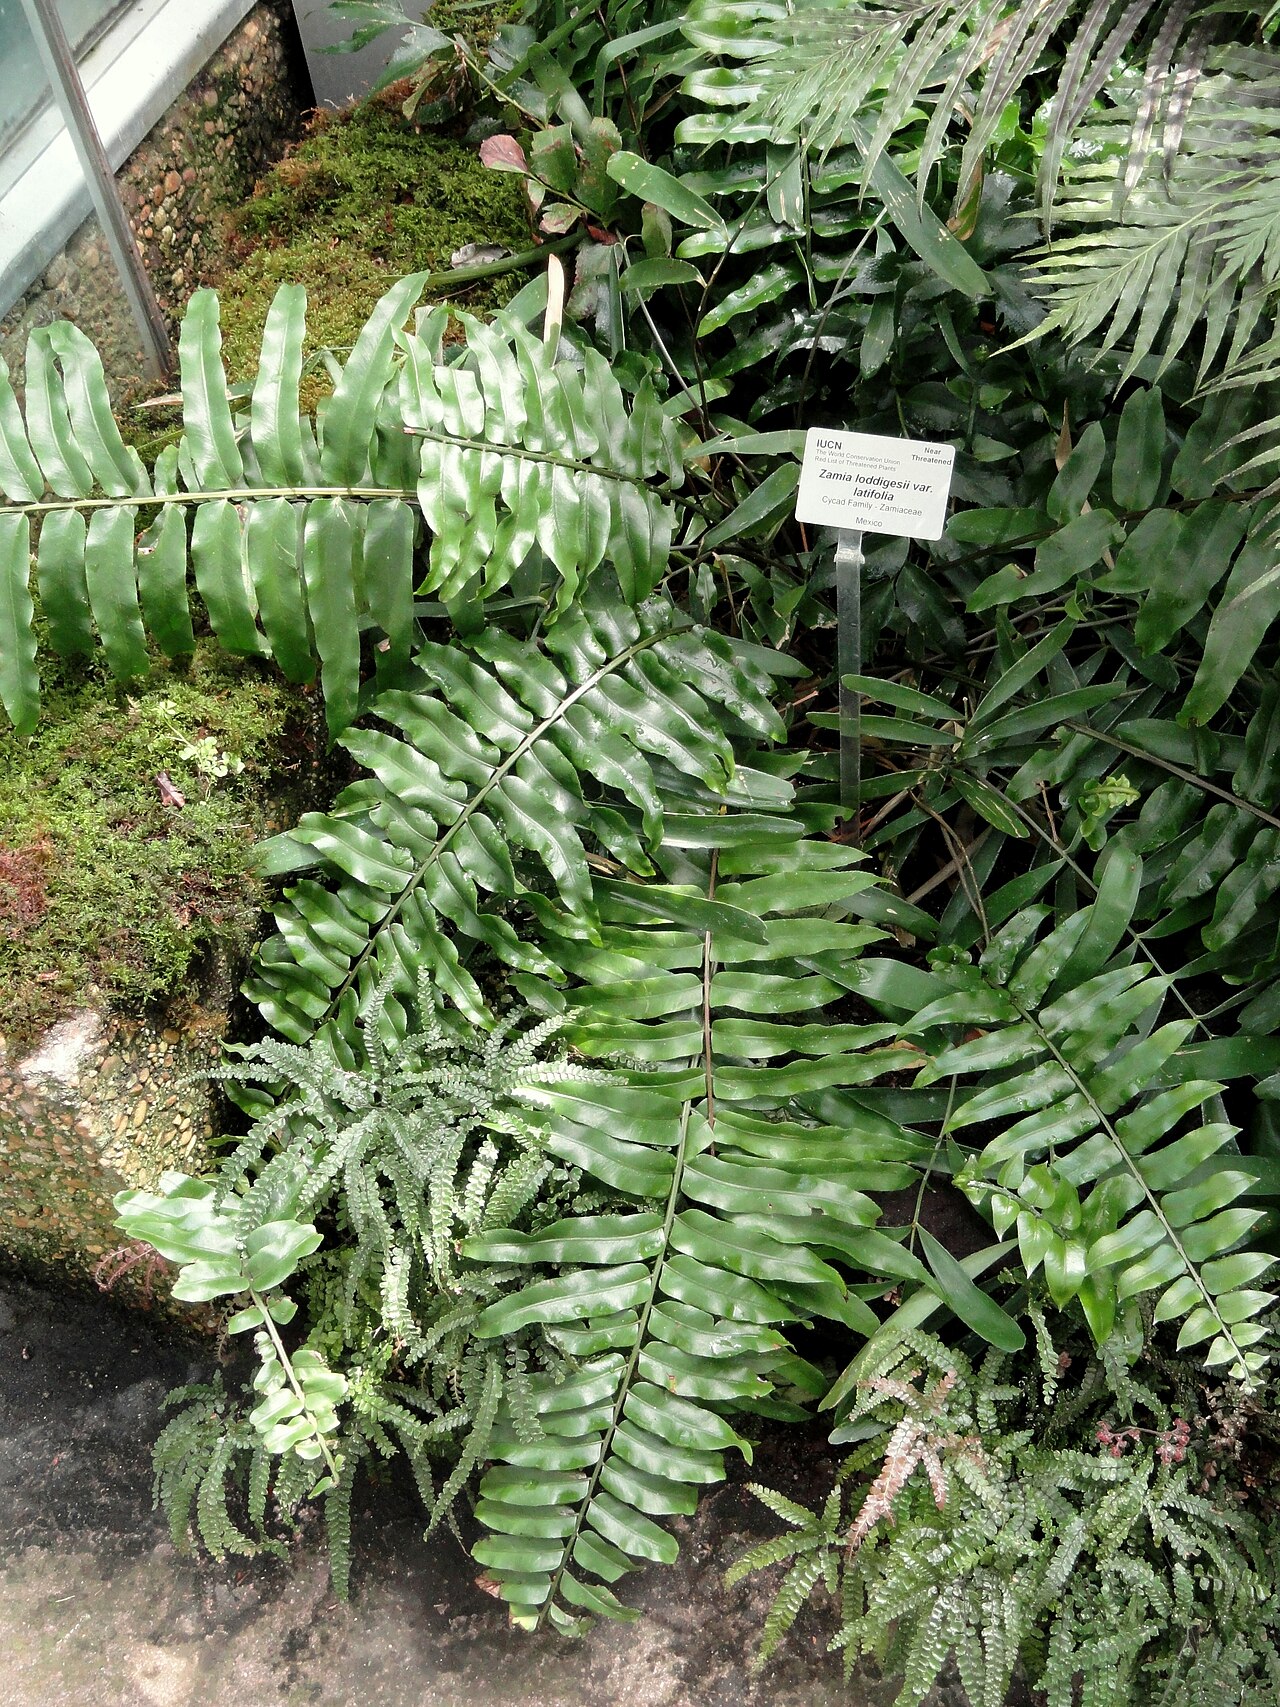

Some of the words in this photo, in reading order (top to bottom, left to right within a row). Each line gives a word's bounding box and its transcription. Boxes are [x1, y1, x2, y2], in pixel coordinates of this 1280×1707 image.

[816, 439, 842, 450] IUCN
[846, 453, 883, 463] Conservation
[911, 455, 952, 465] Threatened
[846, 460, 878, 470] Threatened
[819, 469, 852, 482] Zamia
[855, 474, 910, 490] loddigesii
[913, 483, 933, 493] var.
[853, 488, 894, 501] latifolia
[822, 496, 846, 506] Cycad
[847, 498, 874, 510] Family
[880, 504, 922, 516] Zamiaceae
[856, 517, 883, 527] Mexico
